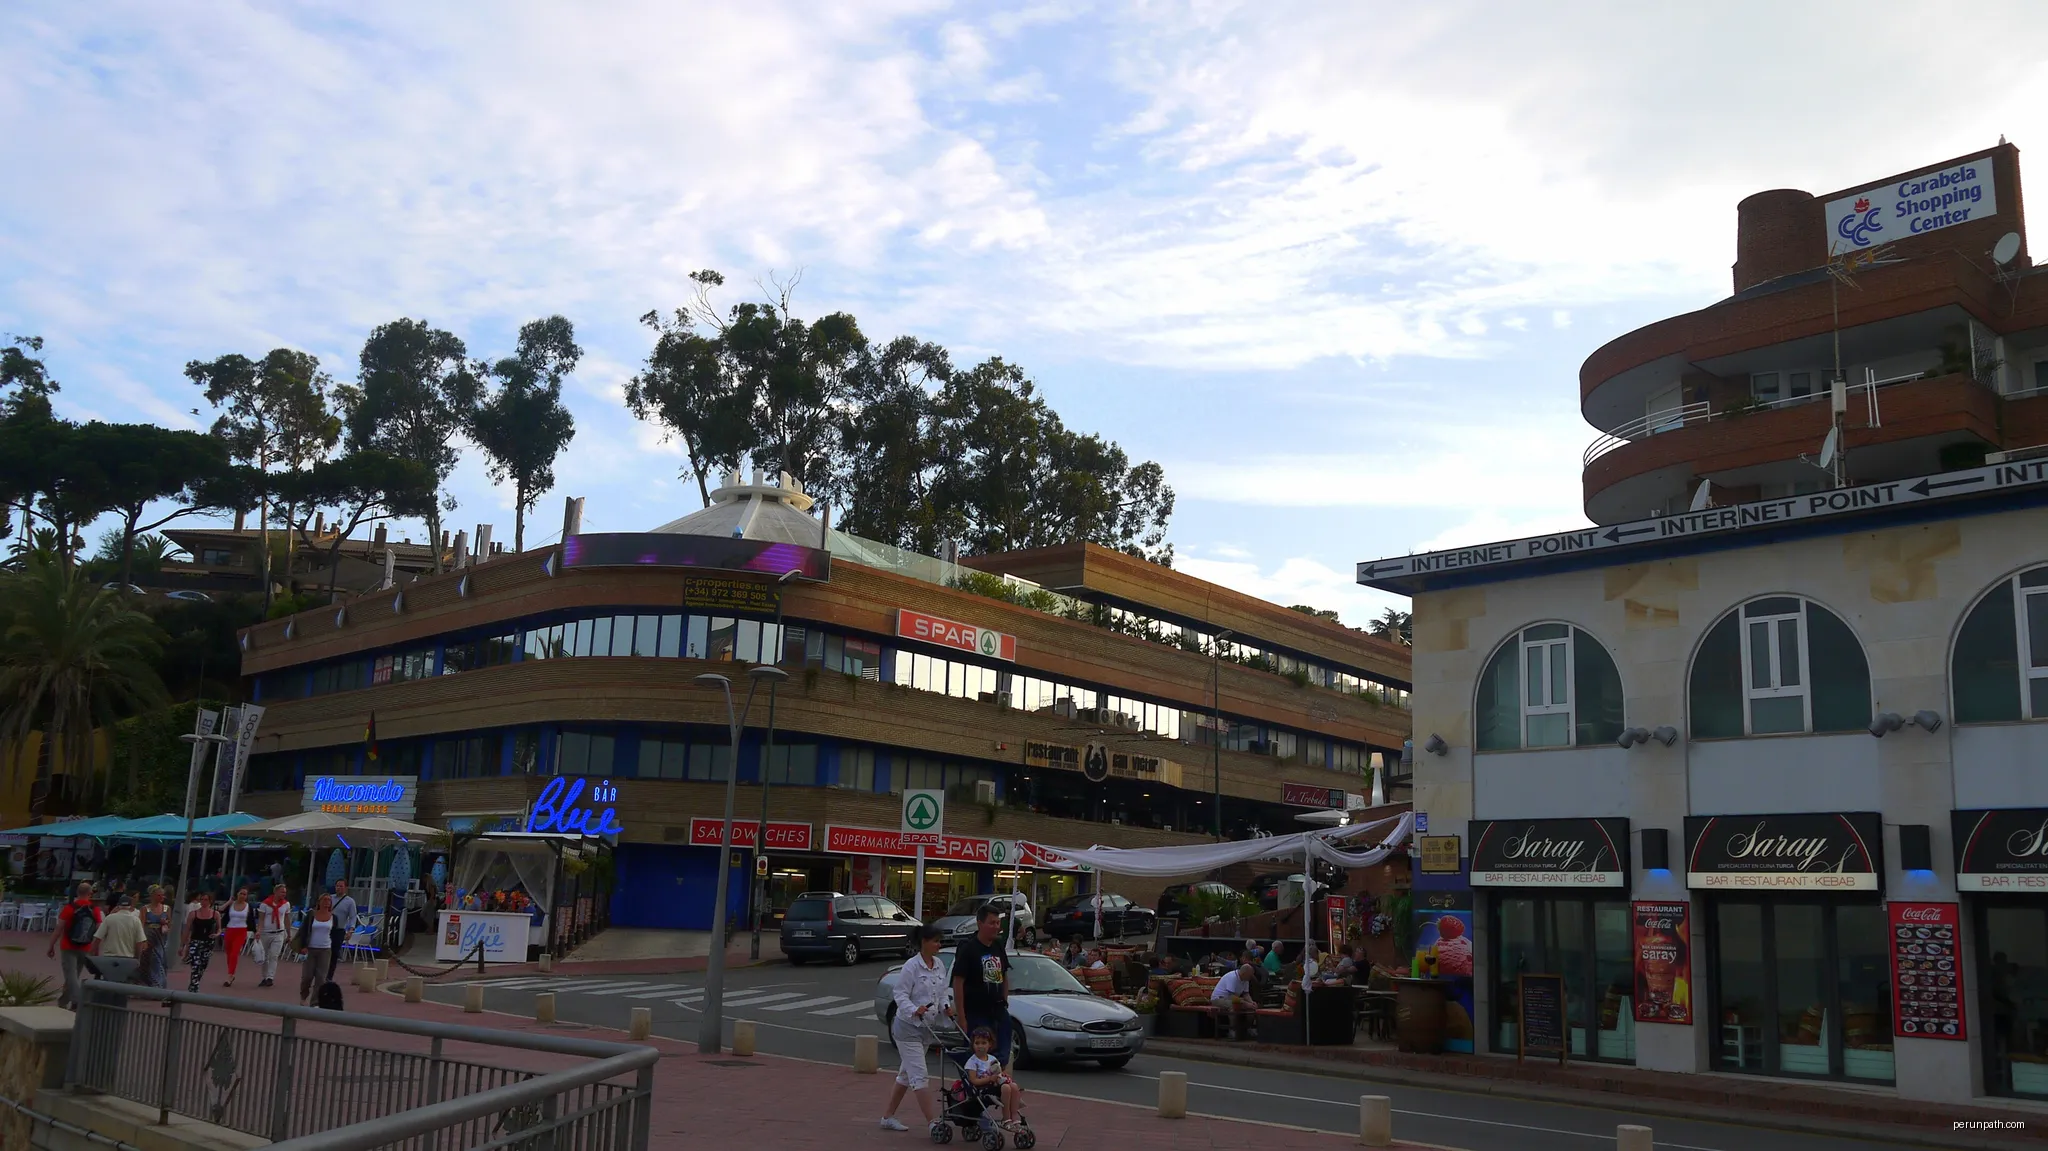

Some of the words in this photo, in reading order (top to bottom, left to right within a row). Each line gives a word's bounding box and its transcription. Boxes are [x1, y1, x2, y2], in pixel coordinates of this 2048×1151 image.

[1899, 166, 1976, 198] Carabela
[1896, 185, 1982, 218] Shopping
[1910, 208, 1971, 233] Center
[1661, 501, 1796, 536] INTERNET
[1810, 484, 1899, 513] POINT
[1412, 544, 1516, 572] INTERNET
[1528, 531, 1598, 556] POINT
[685, 578, 768, 592] c-properties.eu
[685, 587, 709, 597] (+34)
[711, 588, 729, 598] 972
[731, 590, 748, 599] 369
[750, 592, 767, 601] 505
[914, 618, 975, 647] SPAR
[1027, 742, 1079, 765] restaurant
[313, 776, 405, 803] Macondo
[321, 804, 351, 813] BEACH
[356, 805, 388, 814] HOUSE
[527, 776, 624, 835] Blue
[903, 834, 939, 843] SPAR
[935, 840, 988, 858] SPAR
[1503, 825, 1585, 870] Saray
[1727, 821, 1828, 871] Saray
[1485, 873, 1503, 882] BAR
[1508, 873, 1568, 883] RESTAURANT
[1573, 874, 1605, 883] KEBAB
[1706, 876, 1728, 886] BAR
[1735, 876, 1808, 887] RESTAURANT
[1815, 877, 1855, 887] KEBAB
[1981, 876, 2009, 887] BAR
[1636, 905, 1683, 913] RESTAURANT
[460, 922, 504, 953] Blue
[1642, 950, 1677, 964] saray
